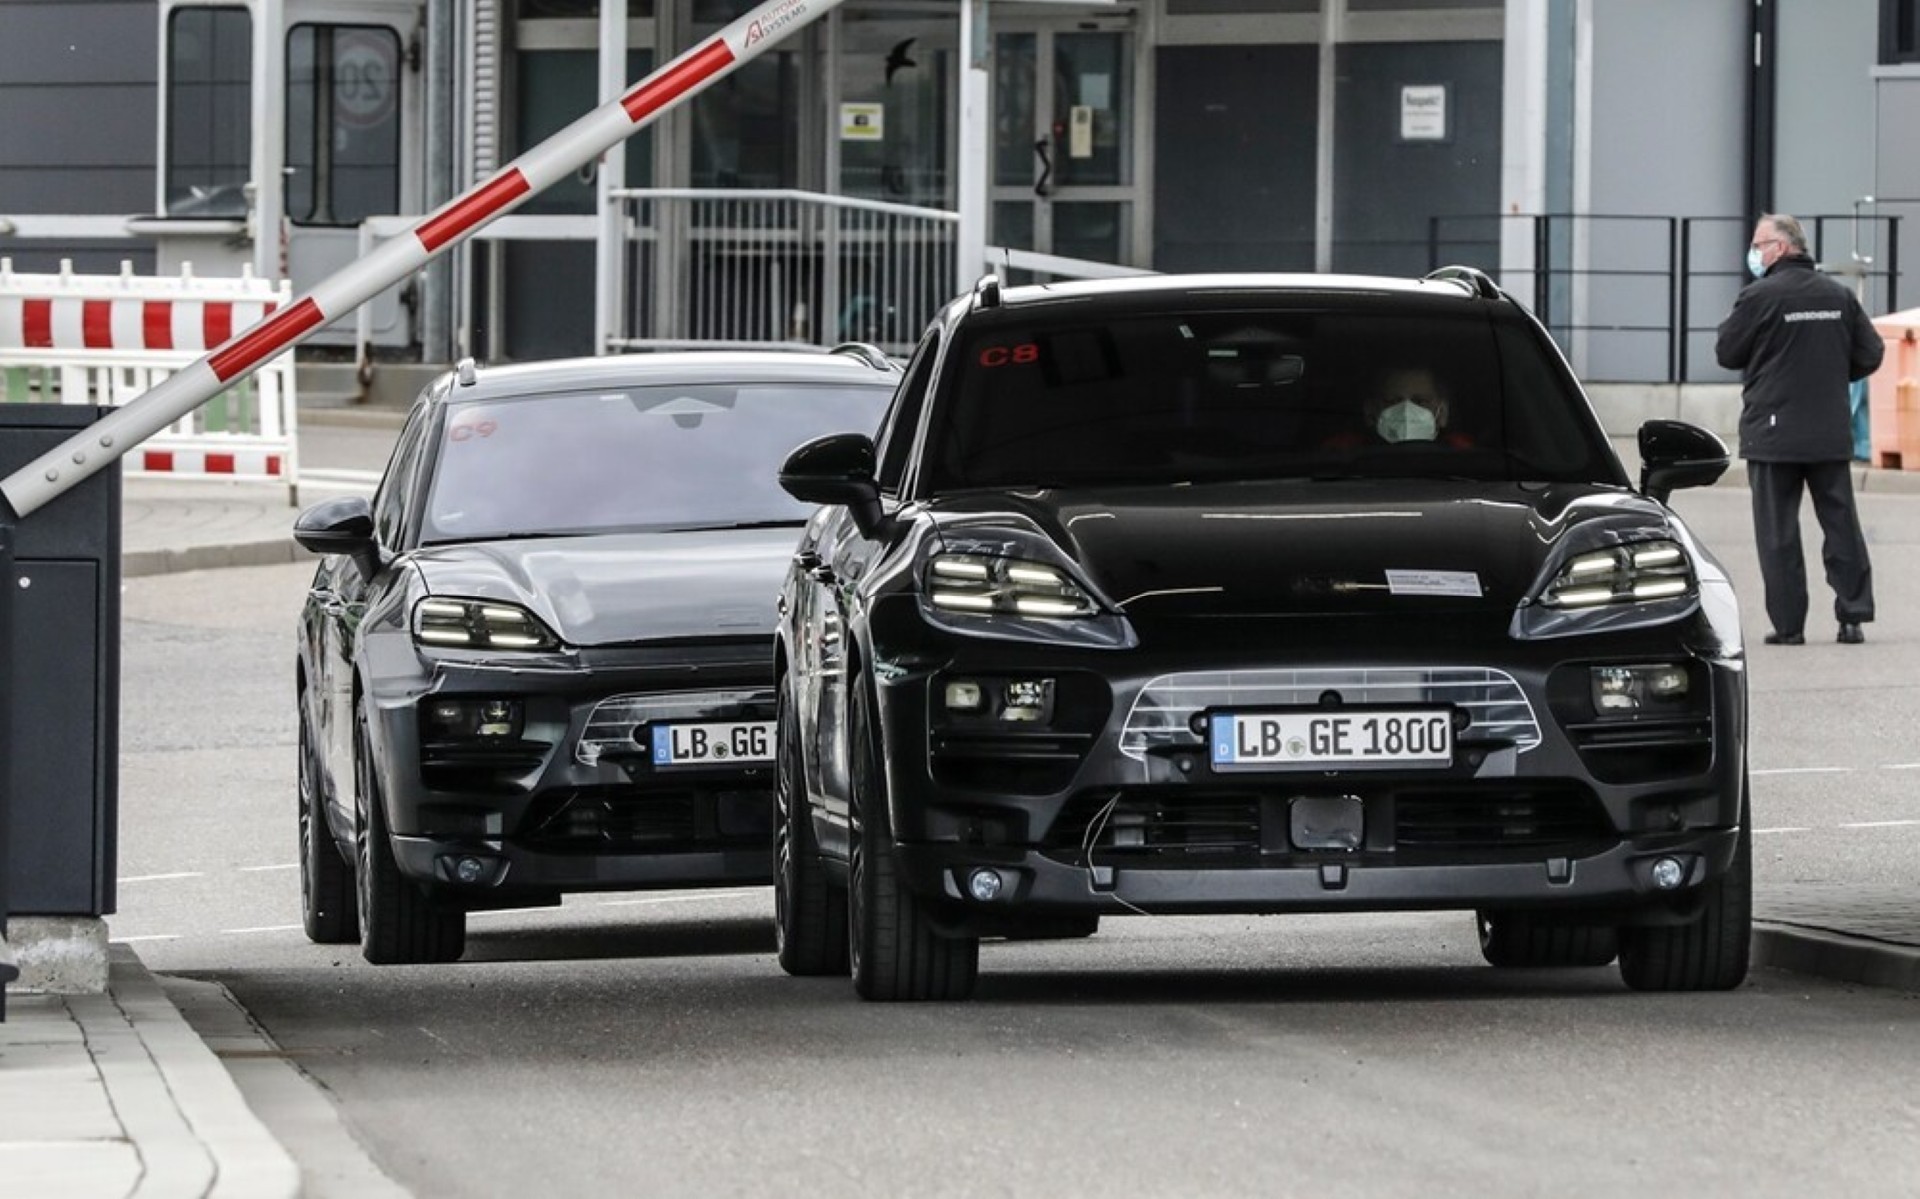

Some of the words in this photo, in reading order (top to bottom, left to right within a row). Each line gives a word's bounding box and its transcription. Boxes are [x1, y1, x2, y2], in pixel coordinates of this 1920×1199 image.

[980, 344, 1039, 367] C8
[450, 420, 498, 442] C9
[672, 727, 708, 759] LB
[731, 725, 767, 756] GG
[1237, 720, 1282, 757] LB
[1309, 719, 1353, 756] GE
[1362, 718, 1446, 755] 1800
[1220, 744, 1229, 756] D
